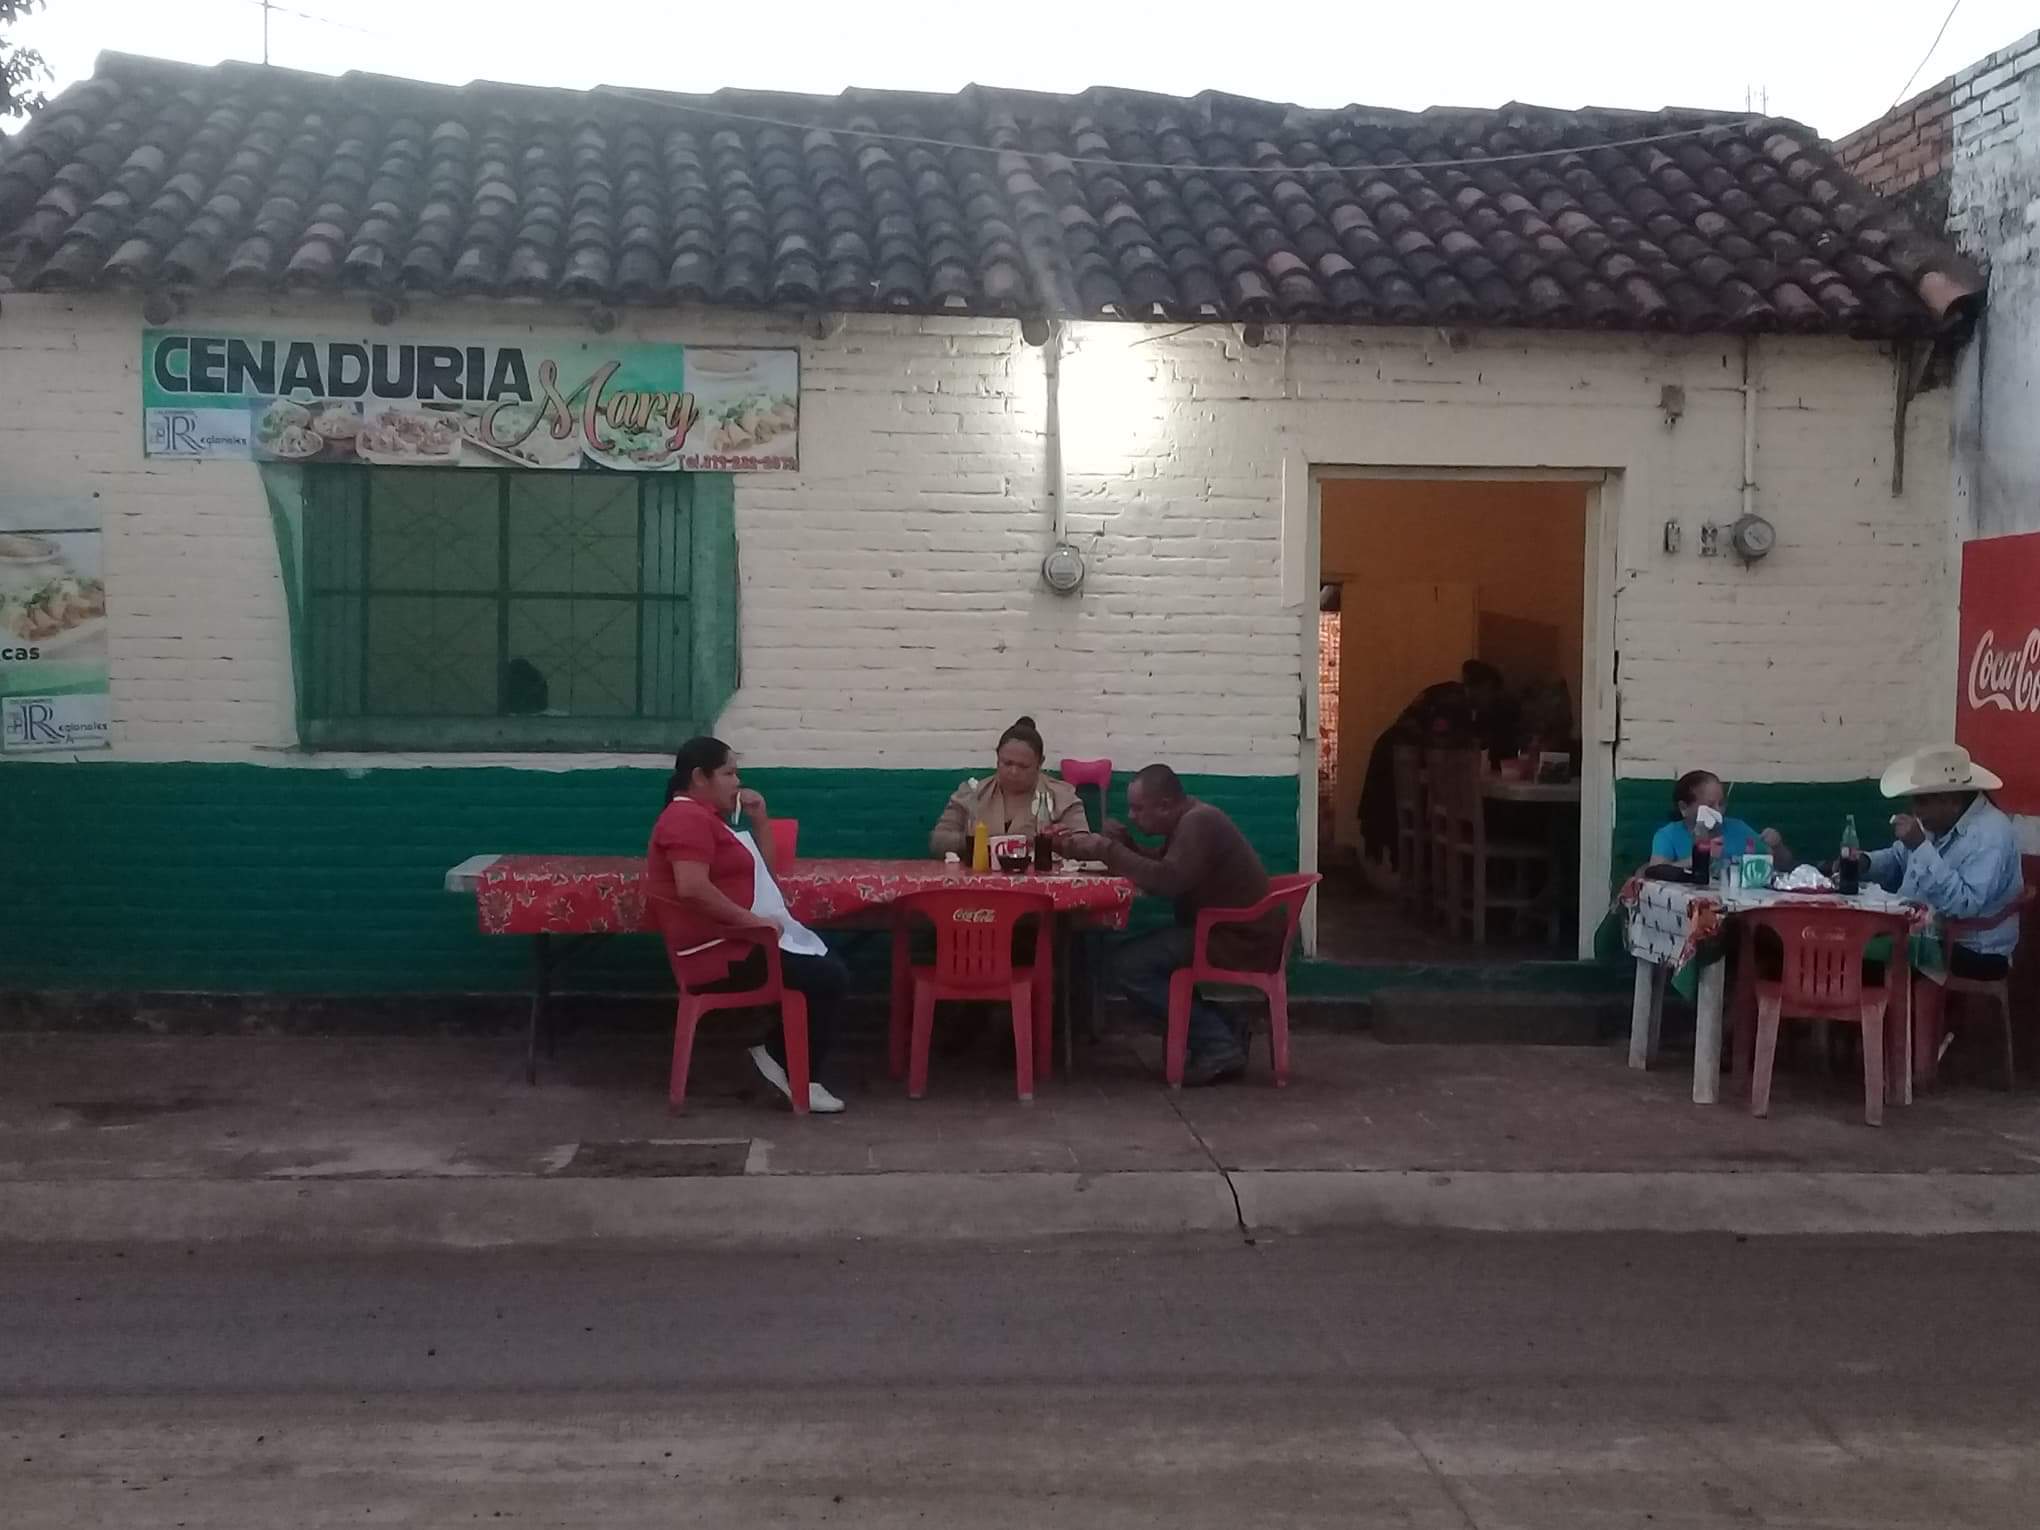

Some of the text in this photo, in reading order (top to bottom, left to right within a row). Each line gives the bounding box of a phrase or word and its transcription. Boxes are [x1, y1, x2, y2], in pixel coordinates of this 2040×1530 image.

[154, 335, 700, 451] CENADURIA Mary
[0, 647, 40, 661] cas
